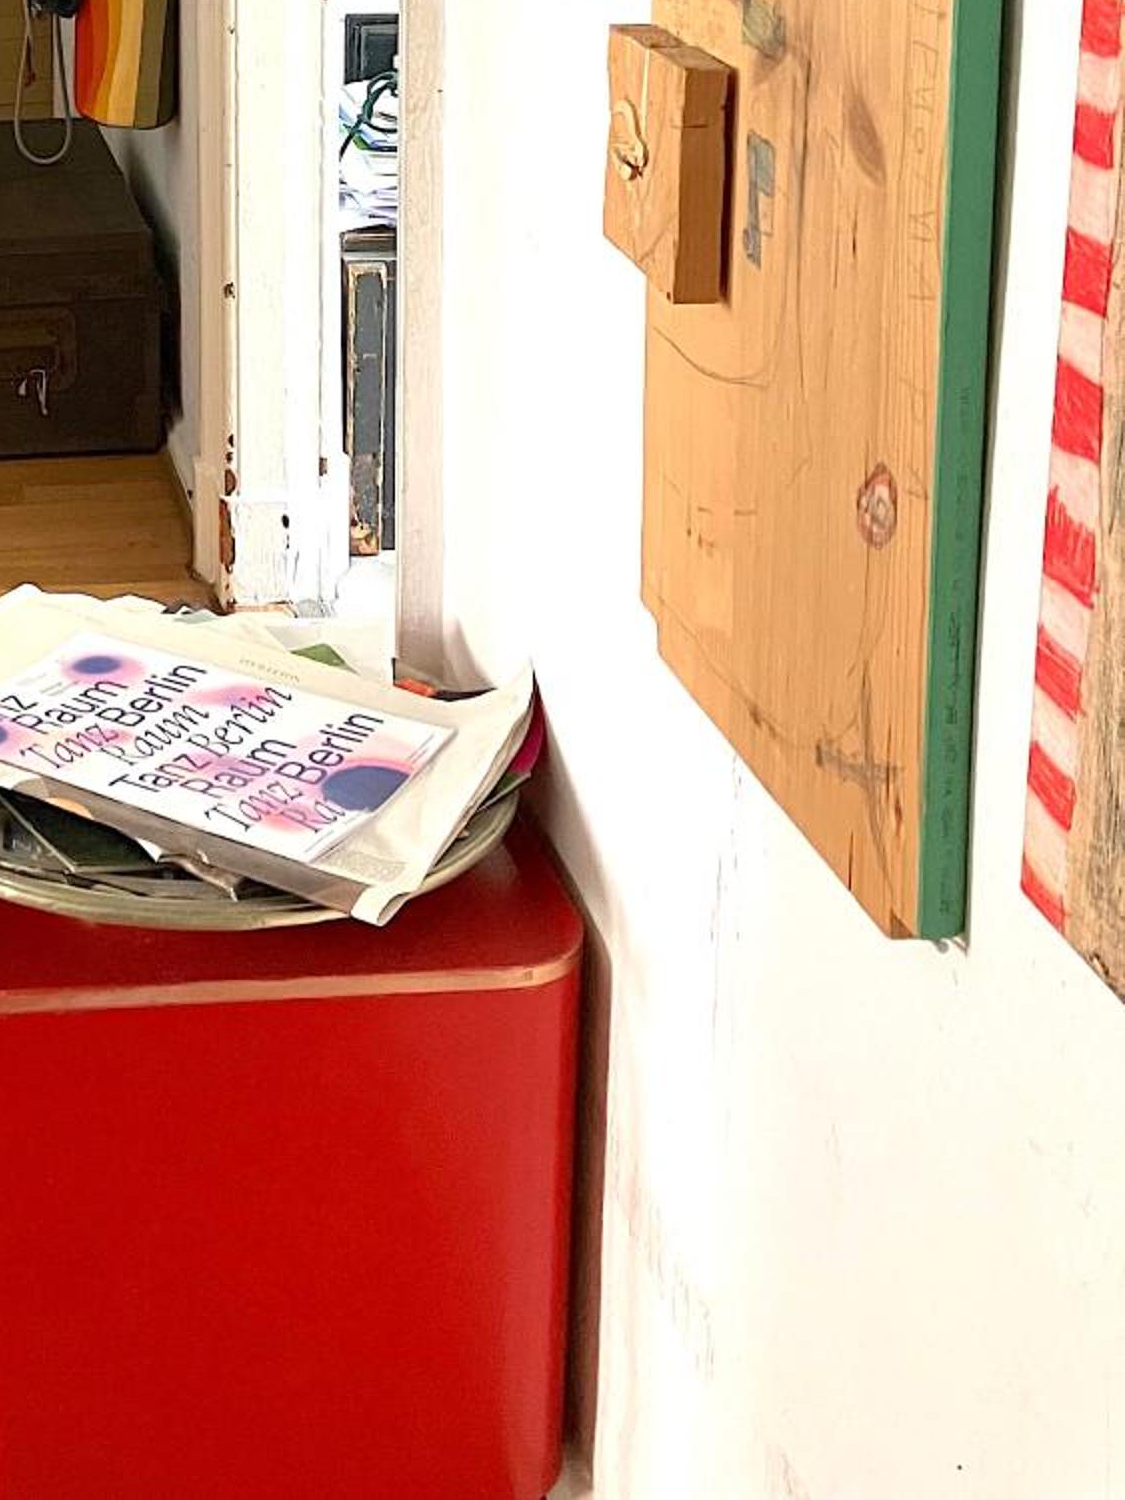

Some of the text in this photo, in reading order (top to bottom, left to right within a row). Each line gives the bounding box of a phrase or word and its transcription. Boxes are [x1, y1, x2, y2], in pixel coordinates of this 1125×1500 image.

[11, 679, 129, 735] Raum
[95, 664, 208, 727] Berlin
[186, 686, 293, 759] Berlin
[19, 723, 120, 769] Tanz
[100, 704, 210, 766] Raum
[277, 711, 385, 786] Berlin
[108, 752, 212, 793] Tanz
[179, 738, 298, 799] Raum
[203, 780, 304, 833] Tanz
